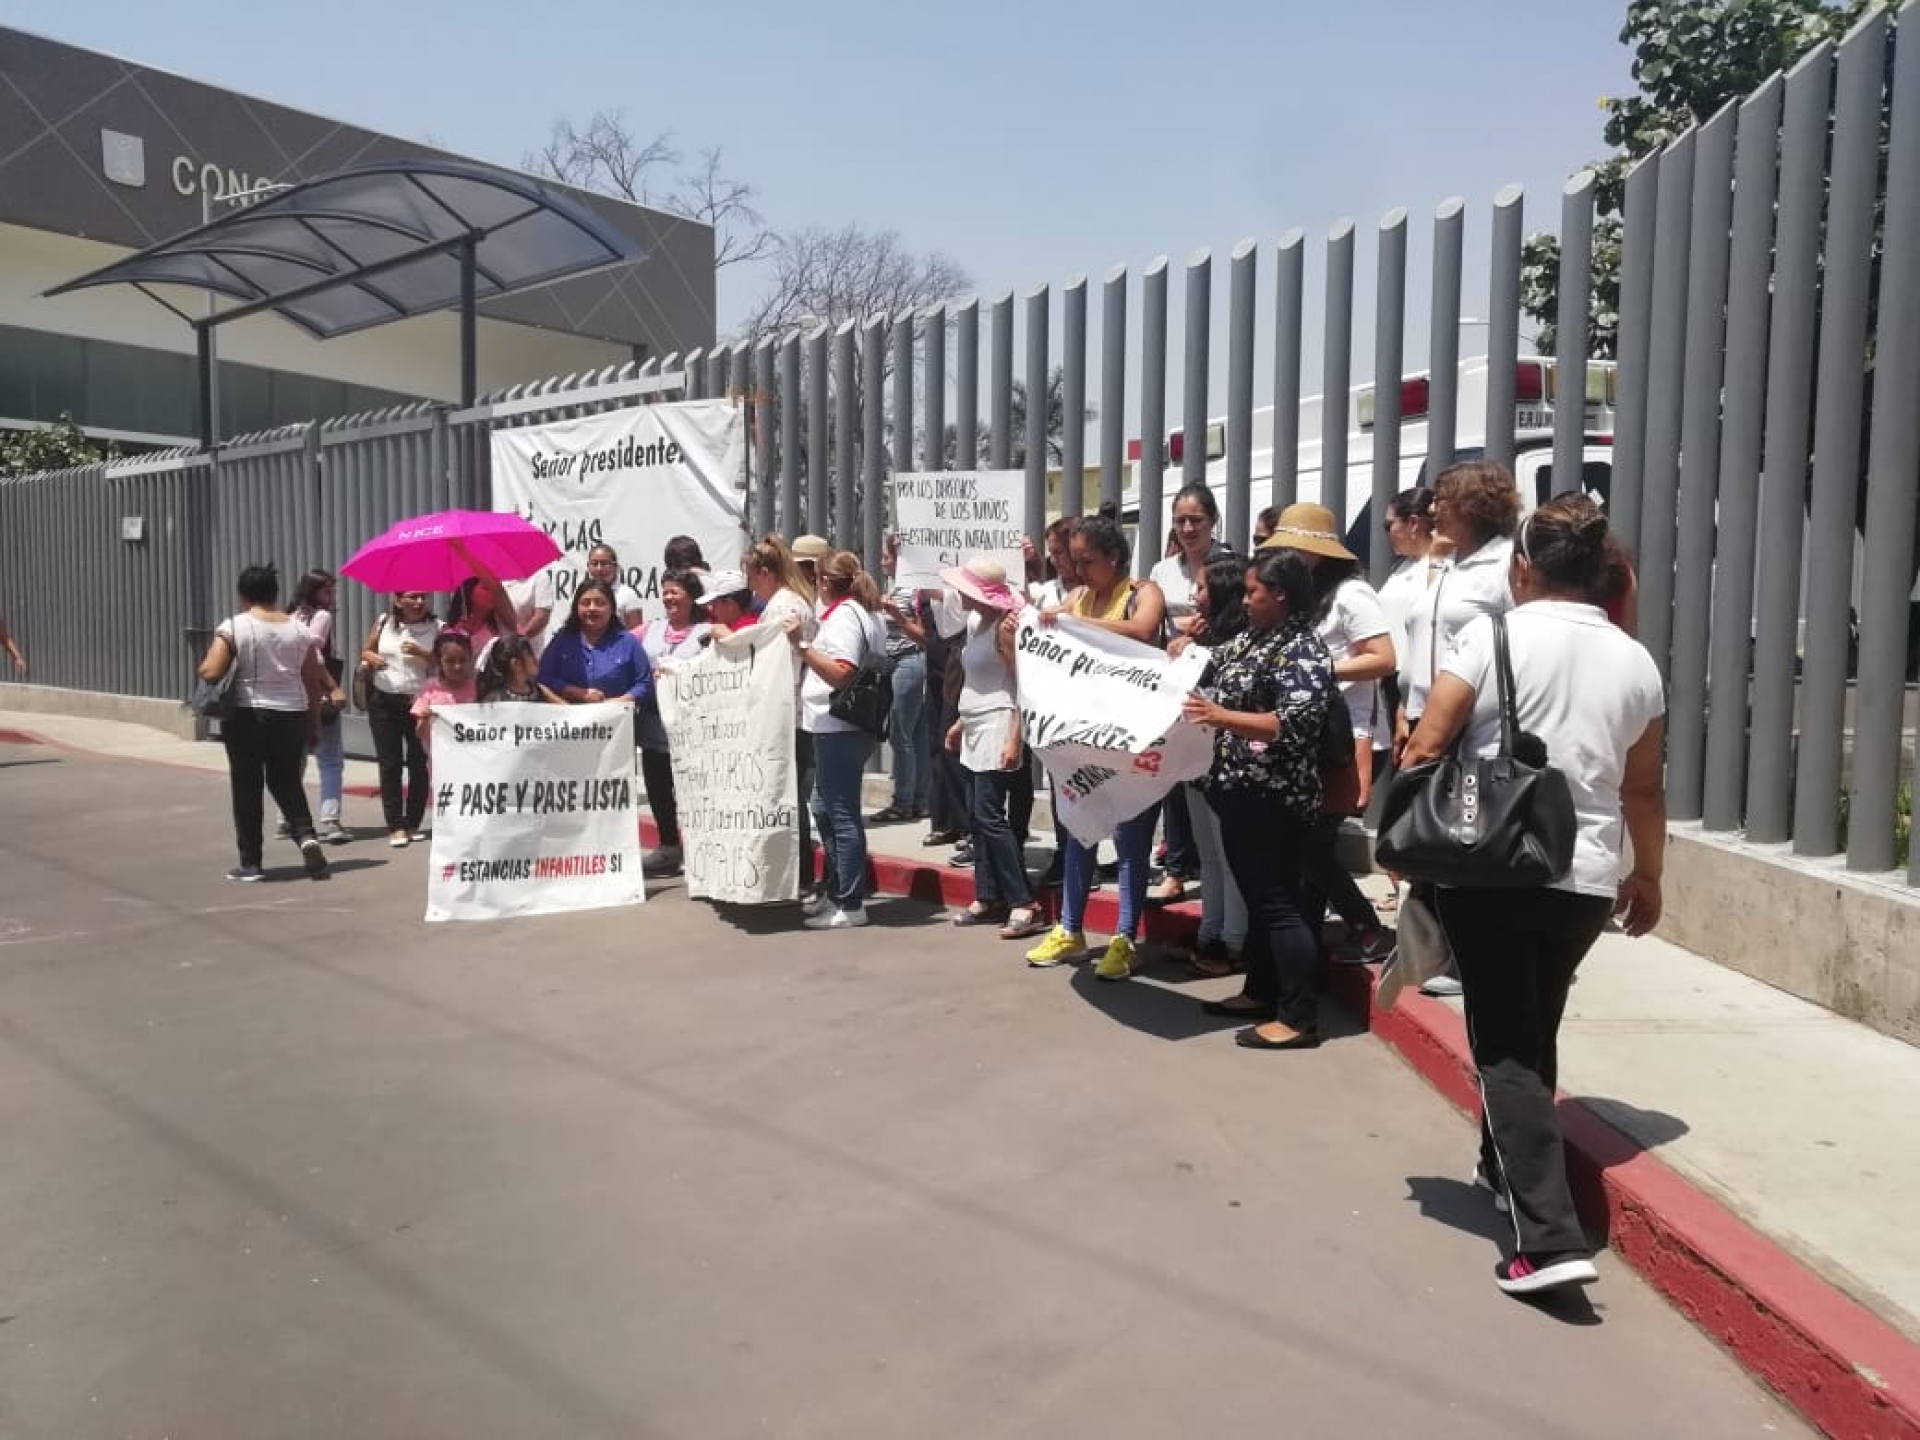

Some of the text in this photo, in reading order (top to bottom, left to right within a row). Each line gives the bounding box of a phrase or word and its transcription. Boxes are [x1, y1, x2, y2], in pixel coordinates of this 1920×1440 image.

[531, 450, 576, 480] Señor
[917, 479, 932, 500] LOS
[934, 501, 946, 519] DE
[950, 501, 970, 520] LOS
[564, 518, 603, 552] LAS
[1018, 625, 1072, 664] Señor
[454, 720, 614, 746] Señor presidente:
[459, 782, 509, 816] PASE
[516, 779, 529, 814] Y
[533, 780, 577, 814] PASE
[582, 778, 631, 812] LISTA
[460, 858, 531, 882] ESTANCIAS
[534, 854, 607, 878] INFANTILES
[610, 852, 623, 873] SI
